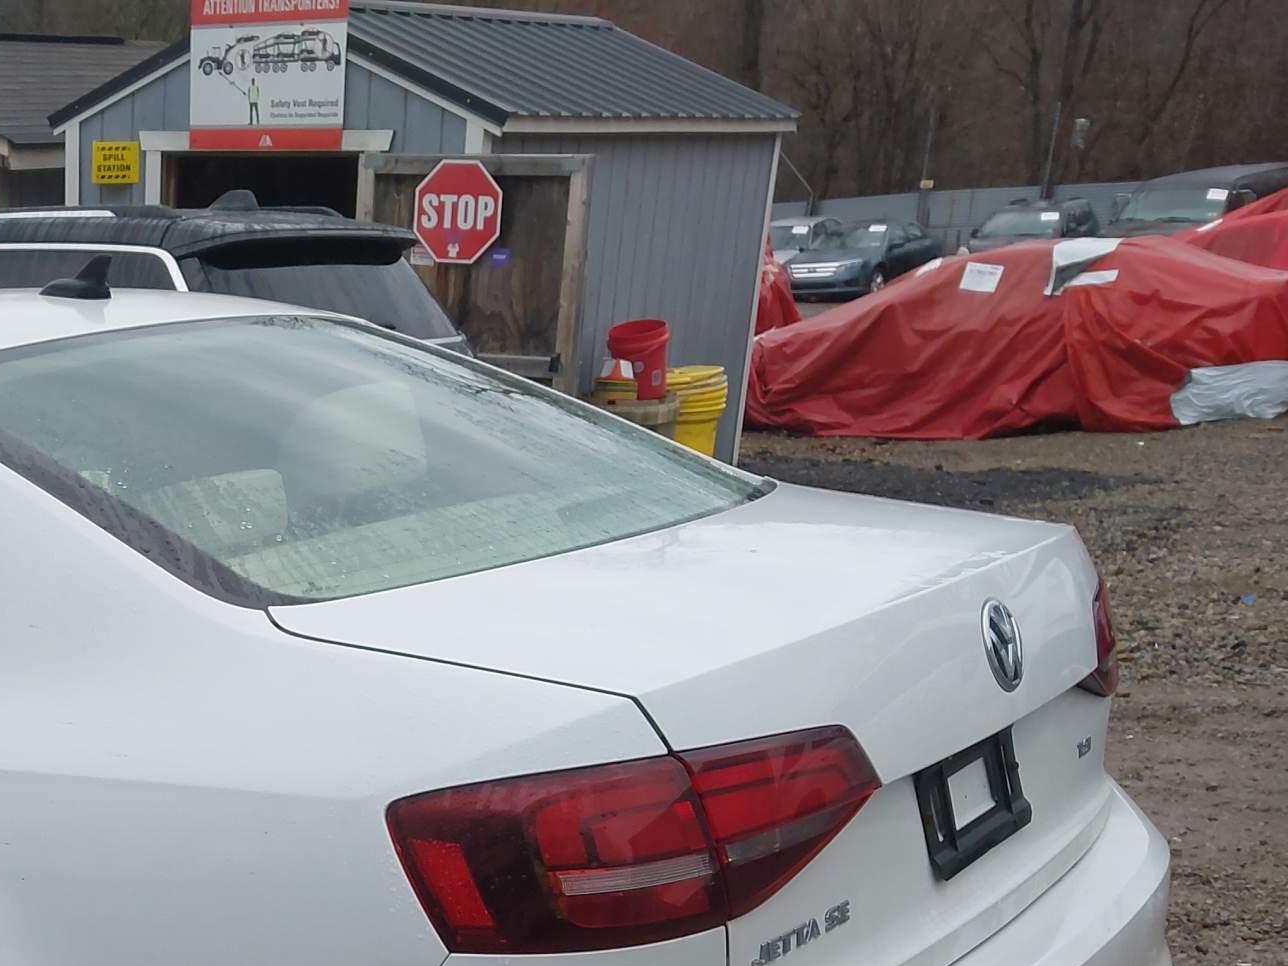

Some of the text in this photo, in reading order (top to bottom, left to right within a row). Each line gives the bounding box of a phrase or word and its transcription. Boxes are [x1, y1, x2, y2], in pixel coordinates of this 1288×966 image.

[97, 164, 132, 172] STATION
[102, 153, 125, 162] SPILL
[421, 193, 495, 231] STOP
[824, 899, 851, 933] SE
